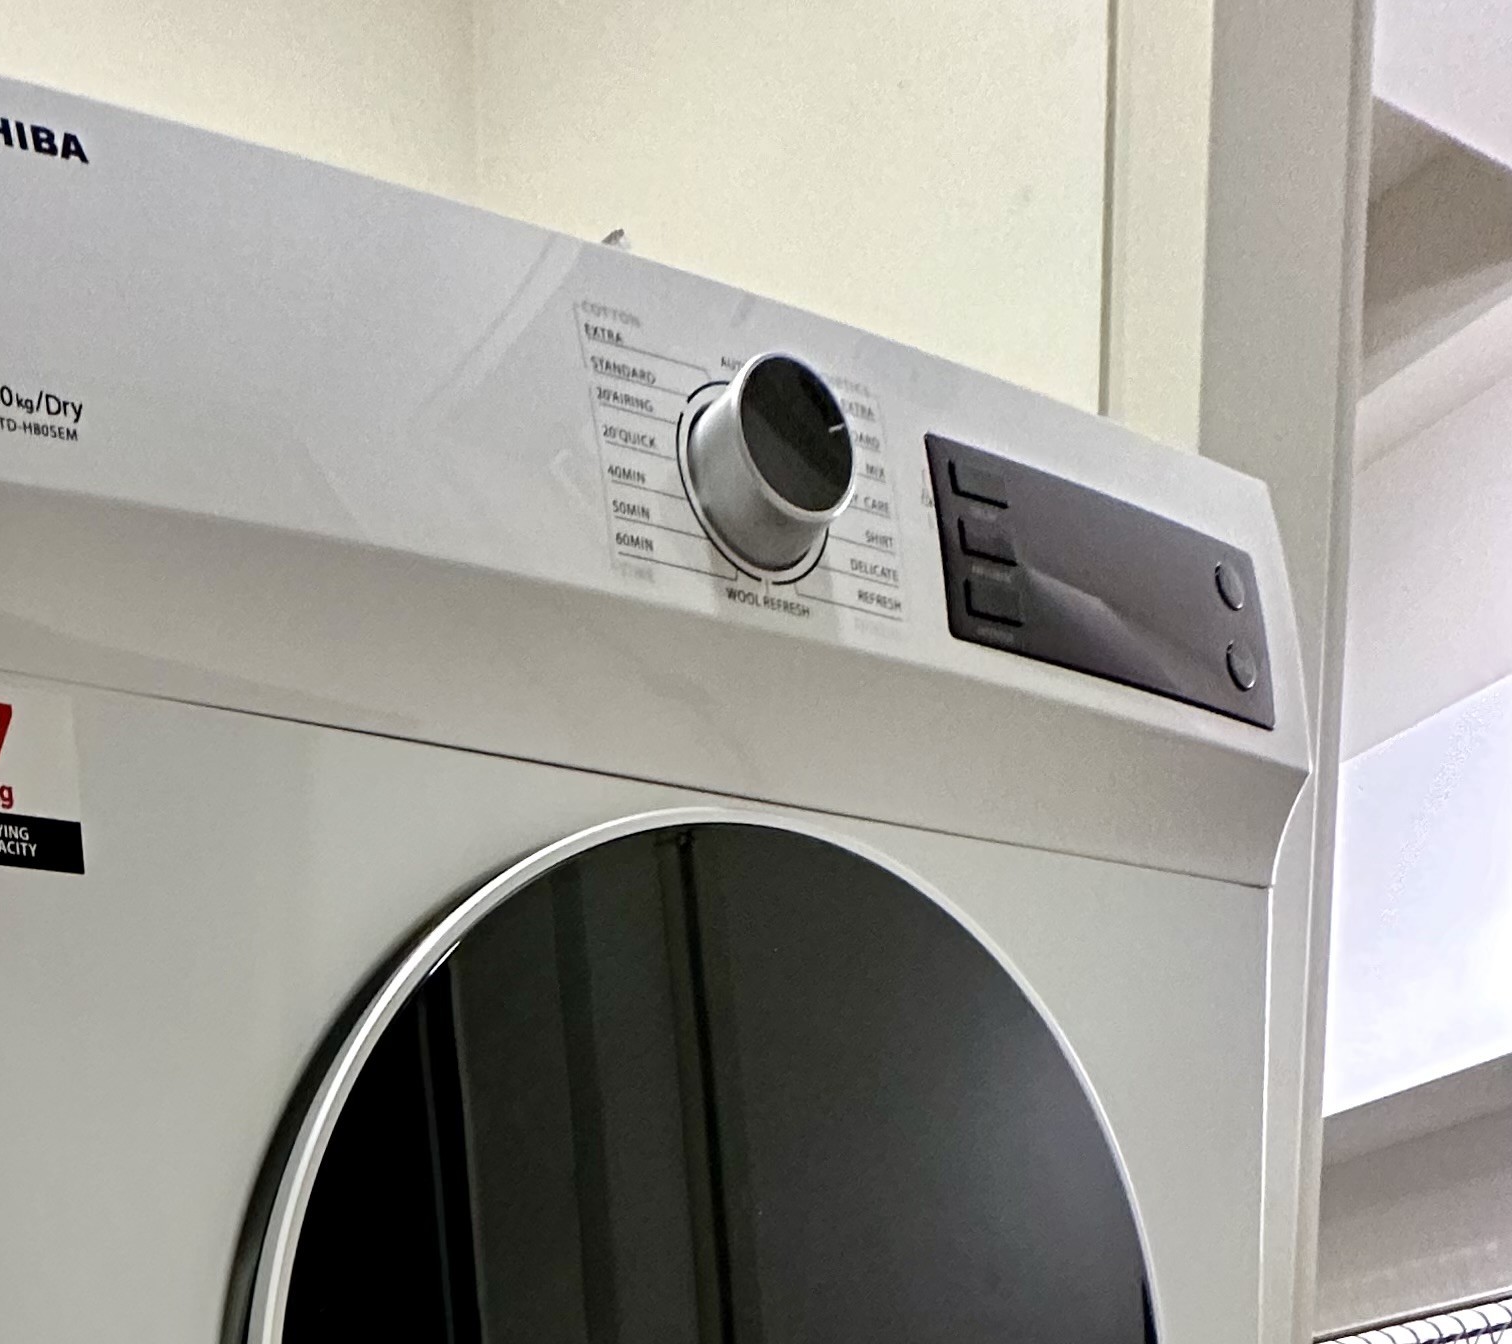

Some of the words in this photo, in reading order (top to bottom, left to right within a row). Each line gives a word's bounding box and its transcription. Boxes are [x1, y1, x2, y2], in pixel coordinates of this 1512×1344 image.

[584, 323, 624, 344] EXTRA
[591, 356, 656, 385] STANDARD
[721, 356, 744, 372] AUT
[608, 464, 646, 484] 40MIN
[866, 463, 885, 479] MIX
[612, 499, 650, 520] 50MIN
[864, 496, 889, 512] CARE
[615, 532, 654, 552] 60MIN
[865, 529, 894, 548] SHIRT
[850, 558, 899, 580] DELICATE
[726, 586, 761, 607] WOOL
[764, 595, 810, 618] REFRESH
[858, 589, 902, 612] REFRESH
